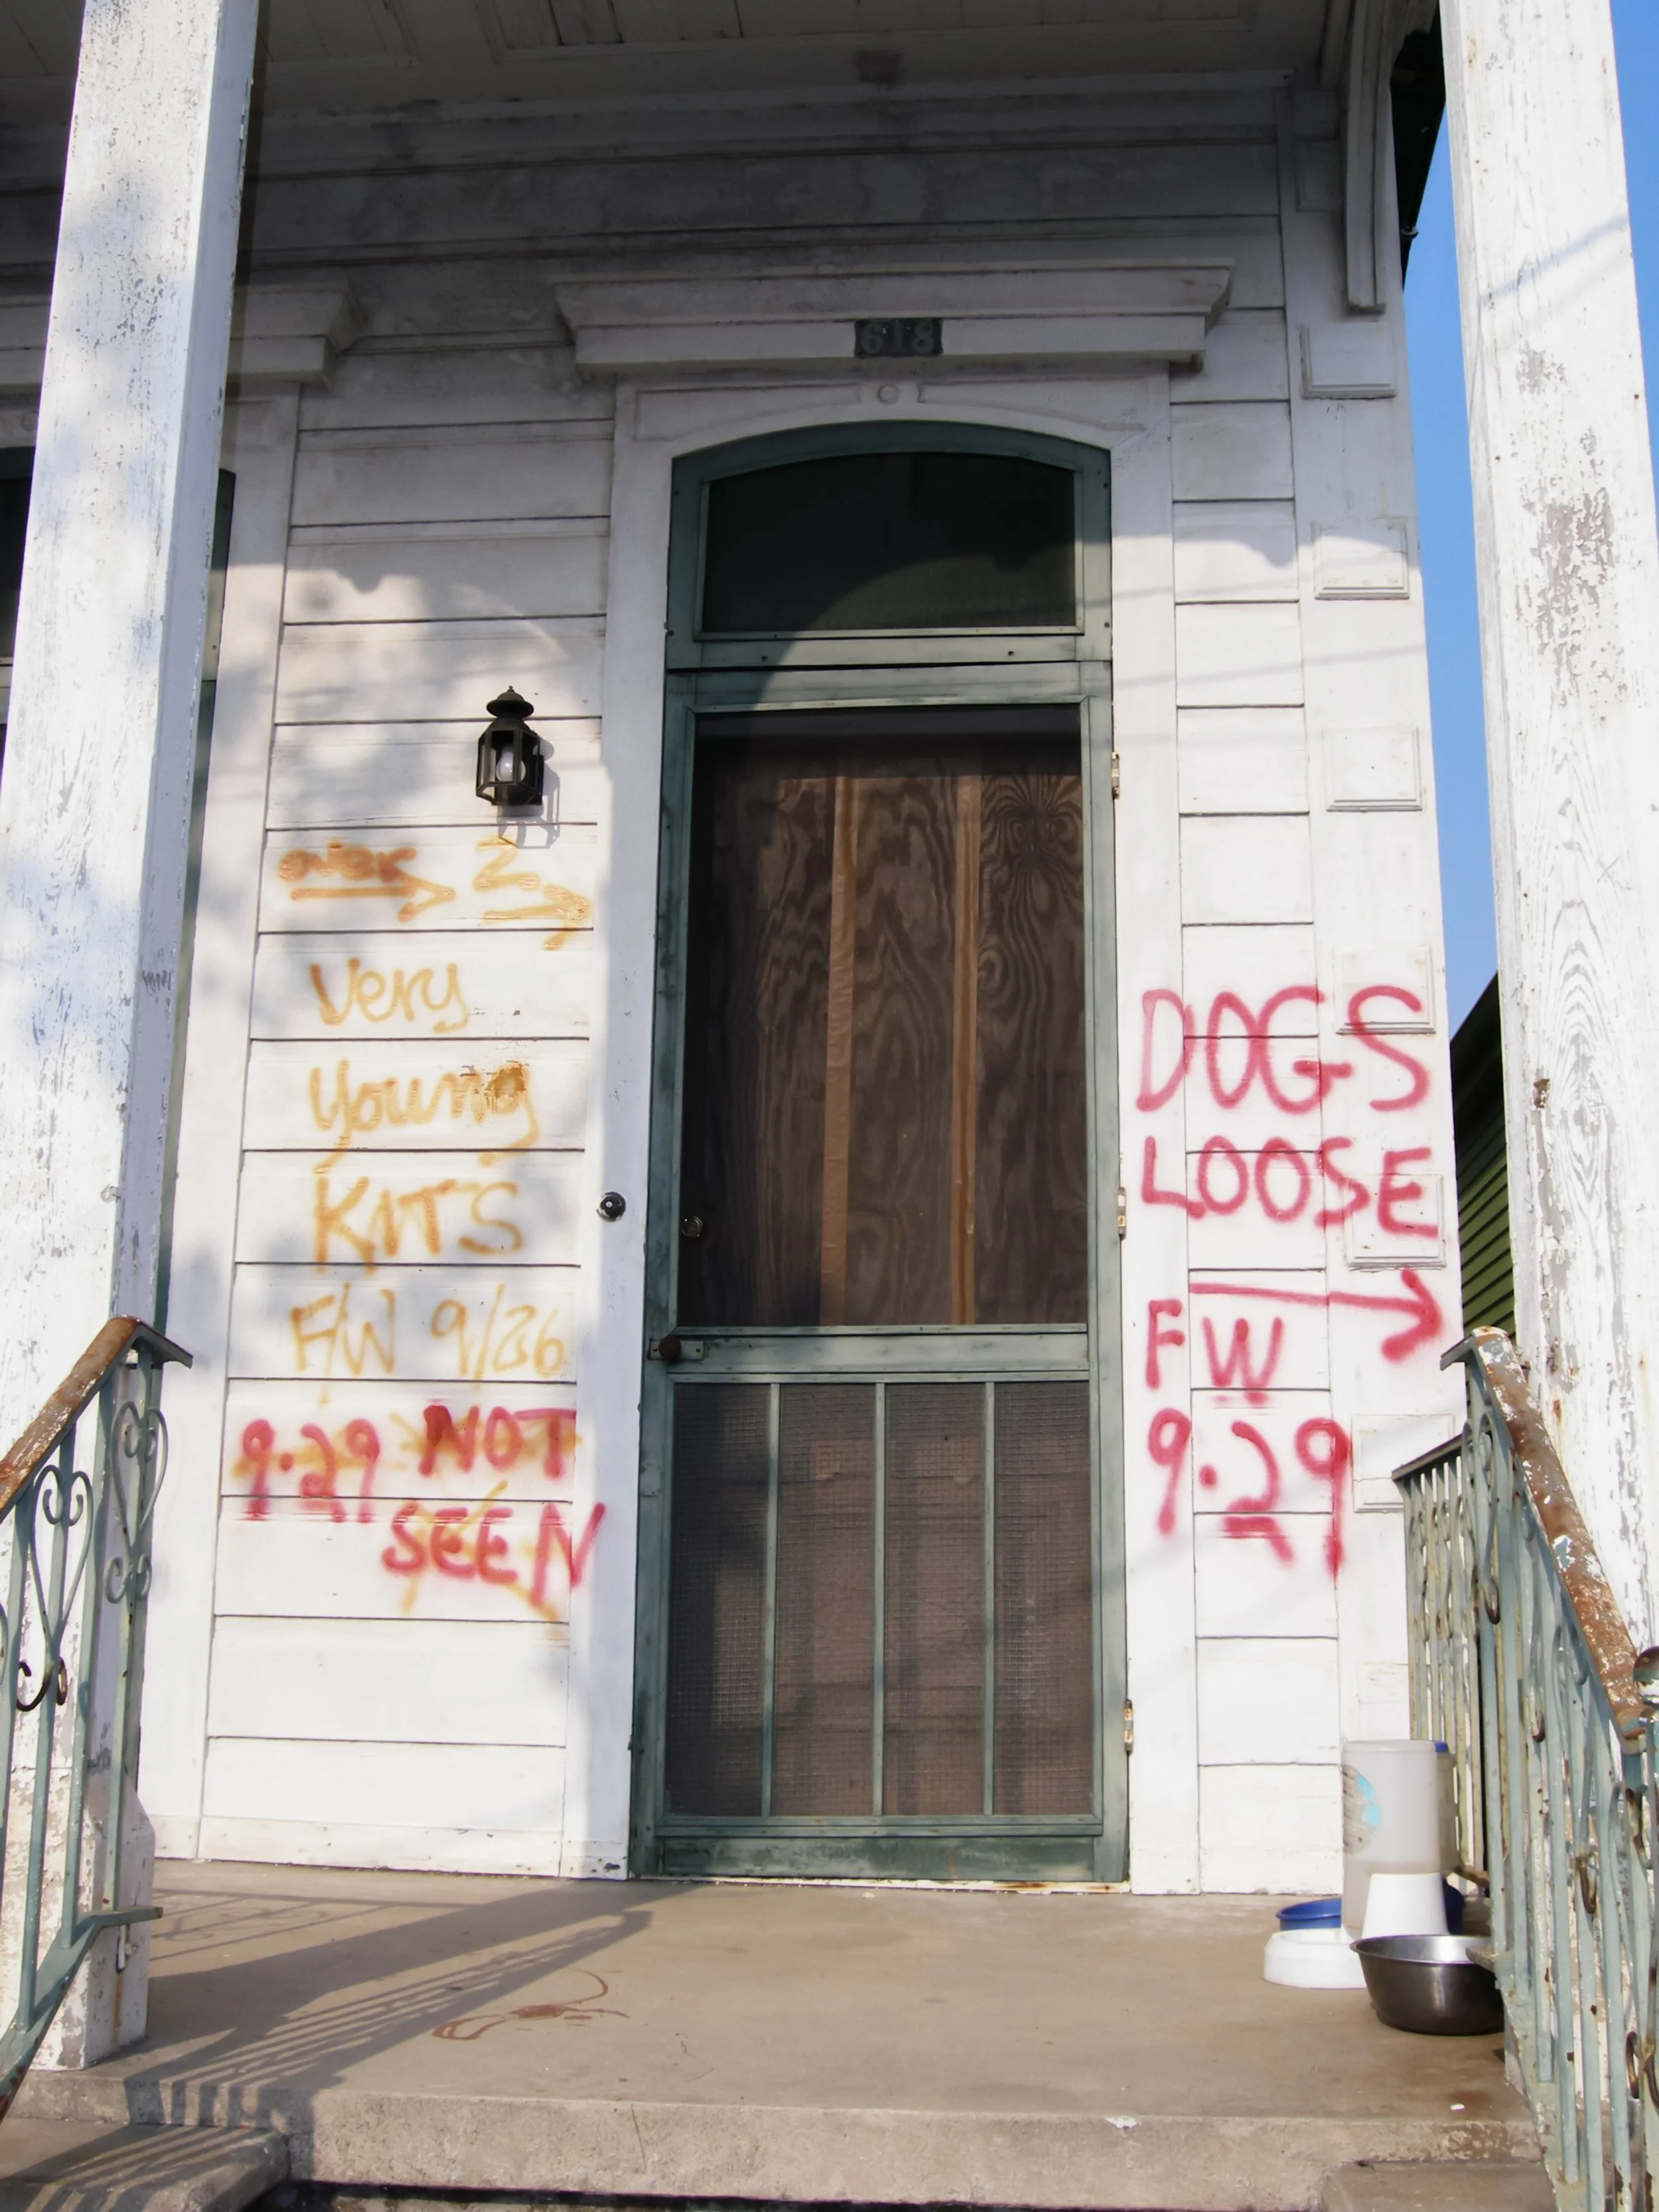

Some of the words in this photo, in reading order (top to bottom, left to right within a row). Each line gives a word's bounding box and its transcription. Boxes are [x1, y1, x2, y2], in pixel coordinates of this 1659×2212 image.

[861, 321, 936, 355] 618
[309, 957, 469, 1033] Very
[1135, 984, 1431, 1116] DOGS
[313, 1175, 525, 1275] KITS
[1140, 1134, 1439, 1239] LOOSE
[431, 1282, 567, 1390] 9/26
[418, 1399, 577, 1479] NOT
[380, 1502, 608, 1606] SEEN
